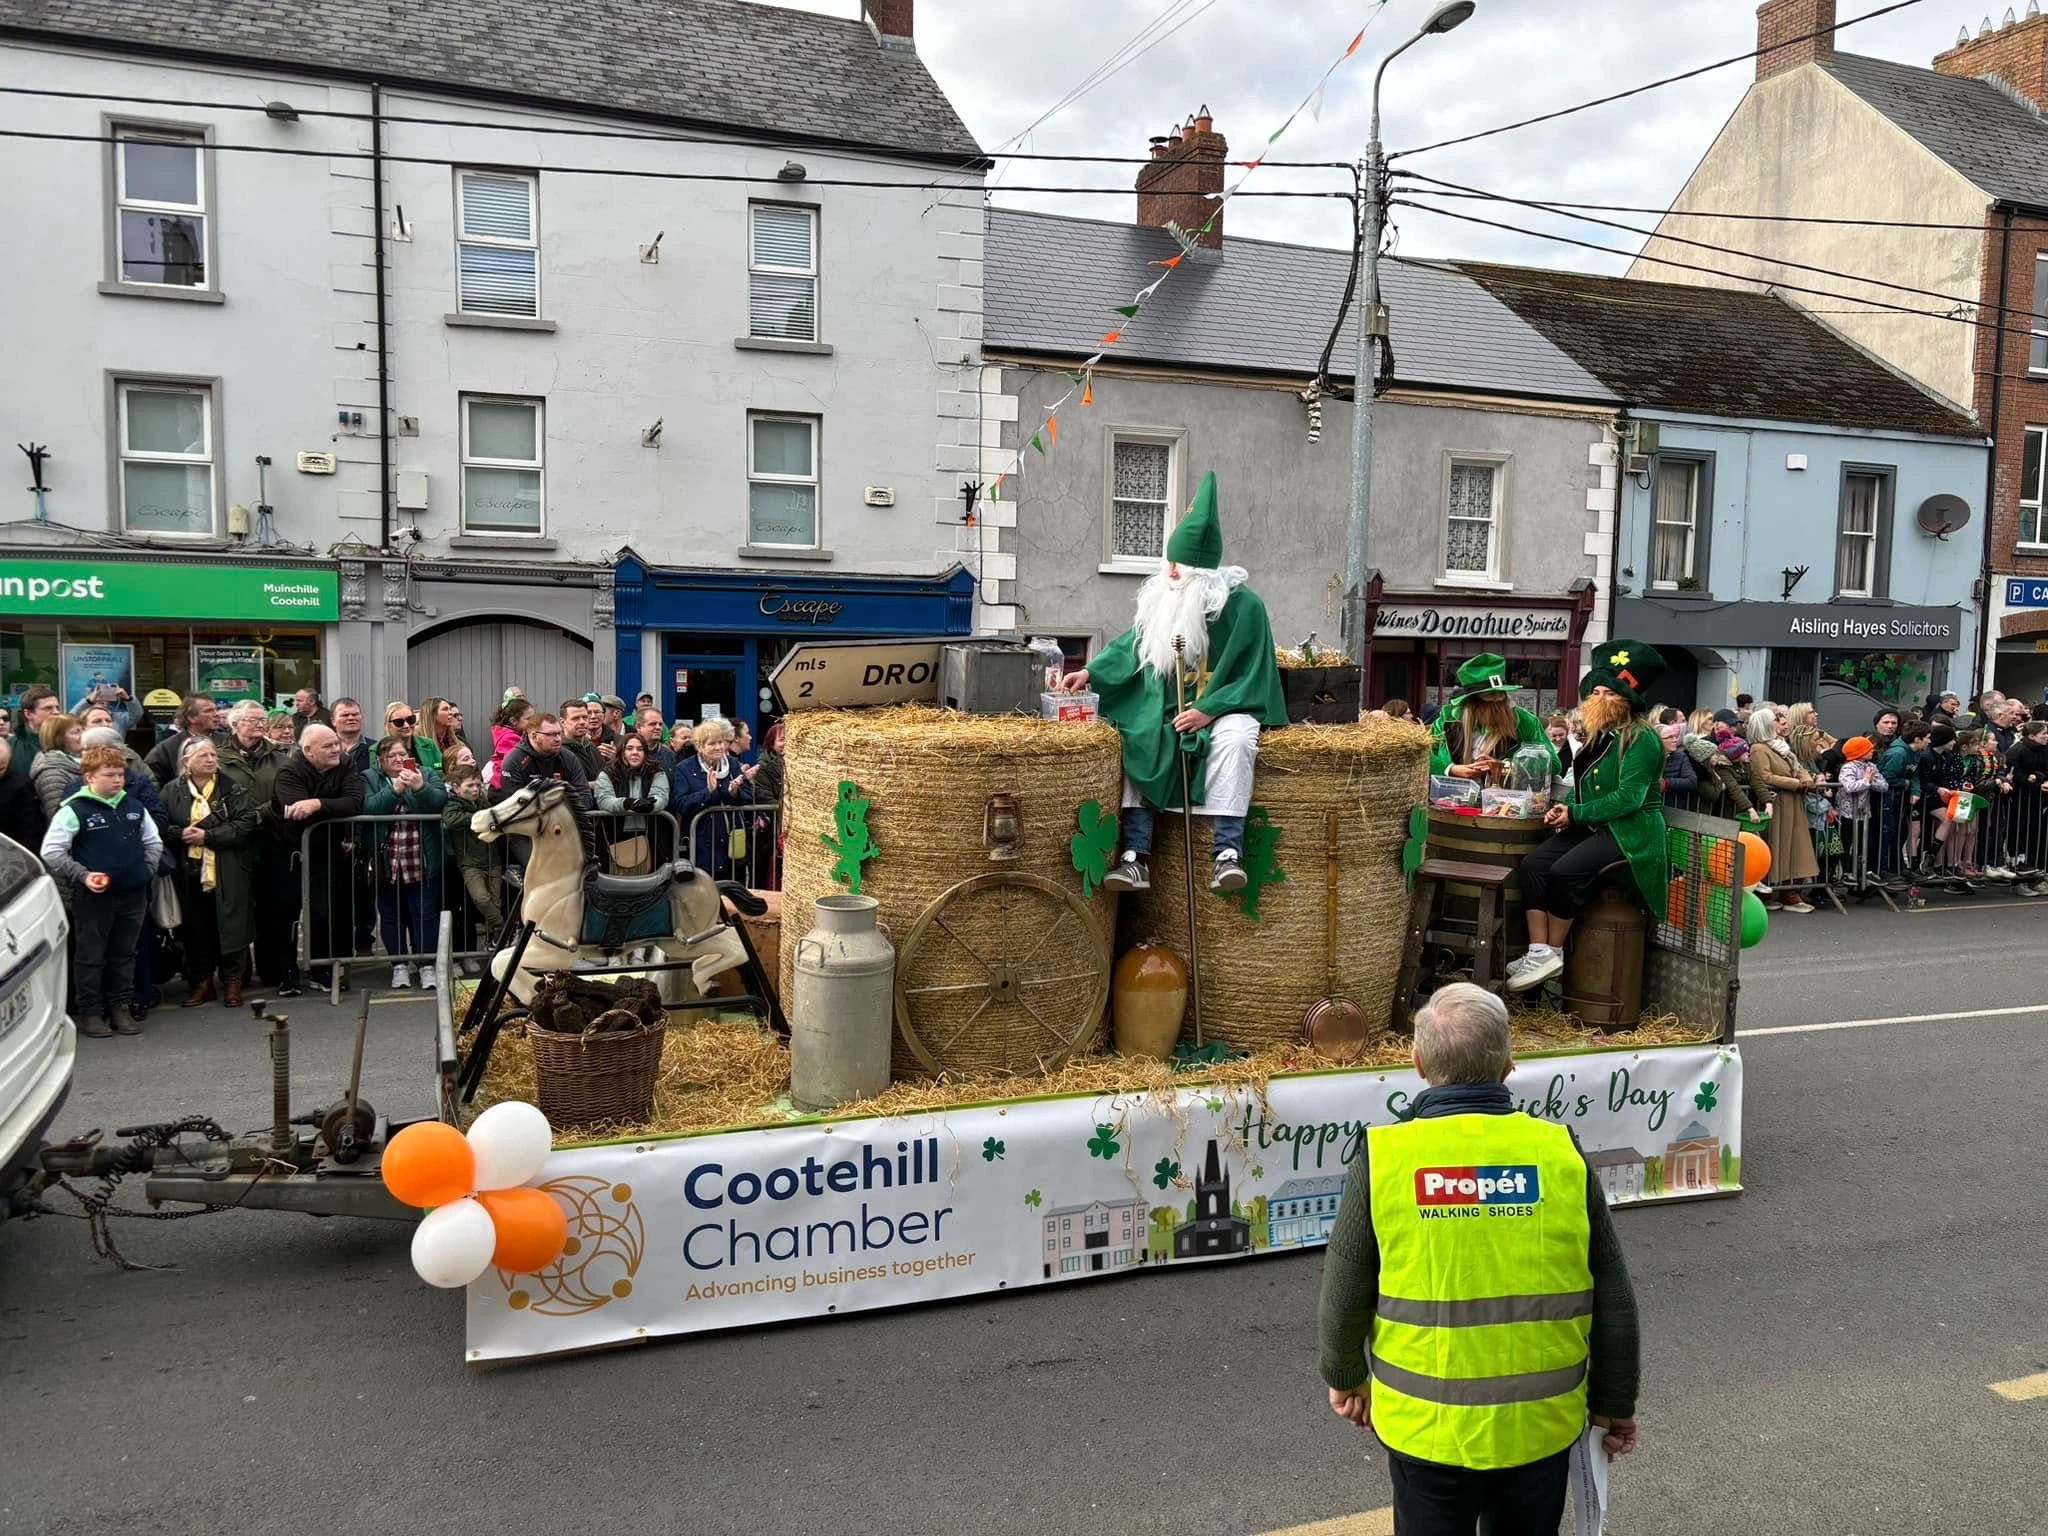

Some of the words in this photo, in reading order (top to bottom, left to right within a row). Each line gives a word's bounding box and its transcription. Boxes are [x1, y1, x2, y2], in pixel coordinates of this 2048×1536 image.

[0, 577, 24, 596] n
[28, 576, 104, 600] post
[264, 584, 320, 594] Muinchille
[270, 596, 320, 606] Cootehill
[760, 592, 842, 623] Escape
[1377, 610, 1419, 628] Wines
[1421, 609, 1523, 635] Donohue
[1524, 614, 1567, 636] Spirits
[1790, 618, 1839, 637] Aisling
[1844, 619, 1887, 638] Hayes
[1890, 620, 1950, 636] Solicitors
[795, 658, 827, 671] mls
[799, 681, 814, 698] 2
[1234, 1103, 1371, 1171] Happy
[1608, 1068, 1675, 1131] Day
[684, 1138, 938, 1209] Cootehill
[1424, 1170, 1527, 1201] Propét
[1420, 1207, 1480, 1219] WALKING
[1488, 1206, 1533, 1217] SHOES
[683, 1203, 952, 1270] Chamber
[685, 1275, 797, 1301] Advancing
[802, 1265, 887, 1288] business
[892, 1252, 976, 1277] together
